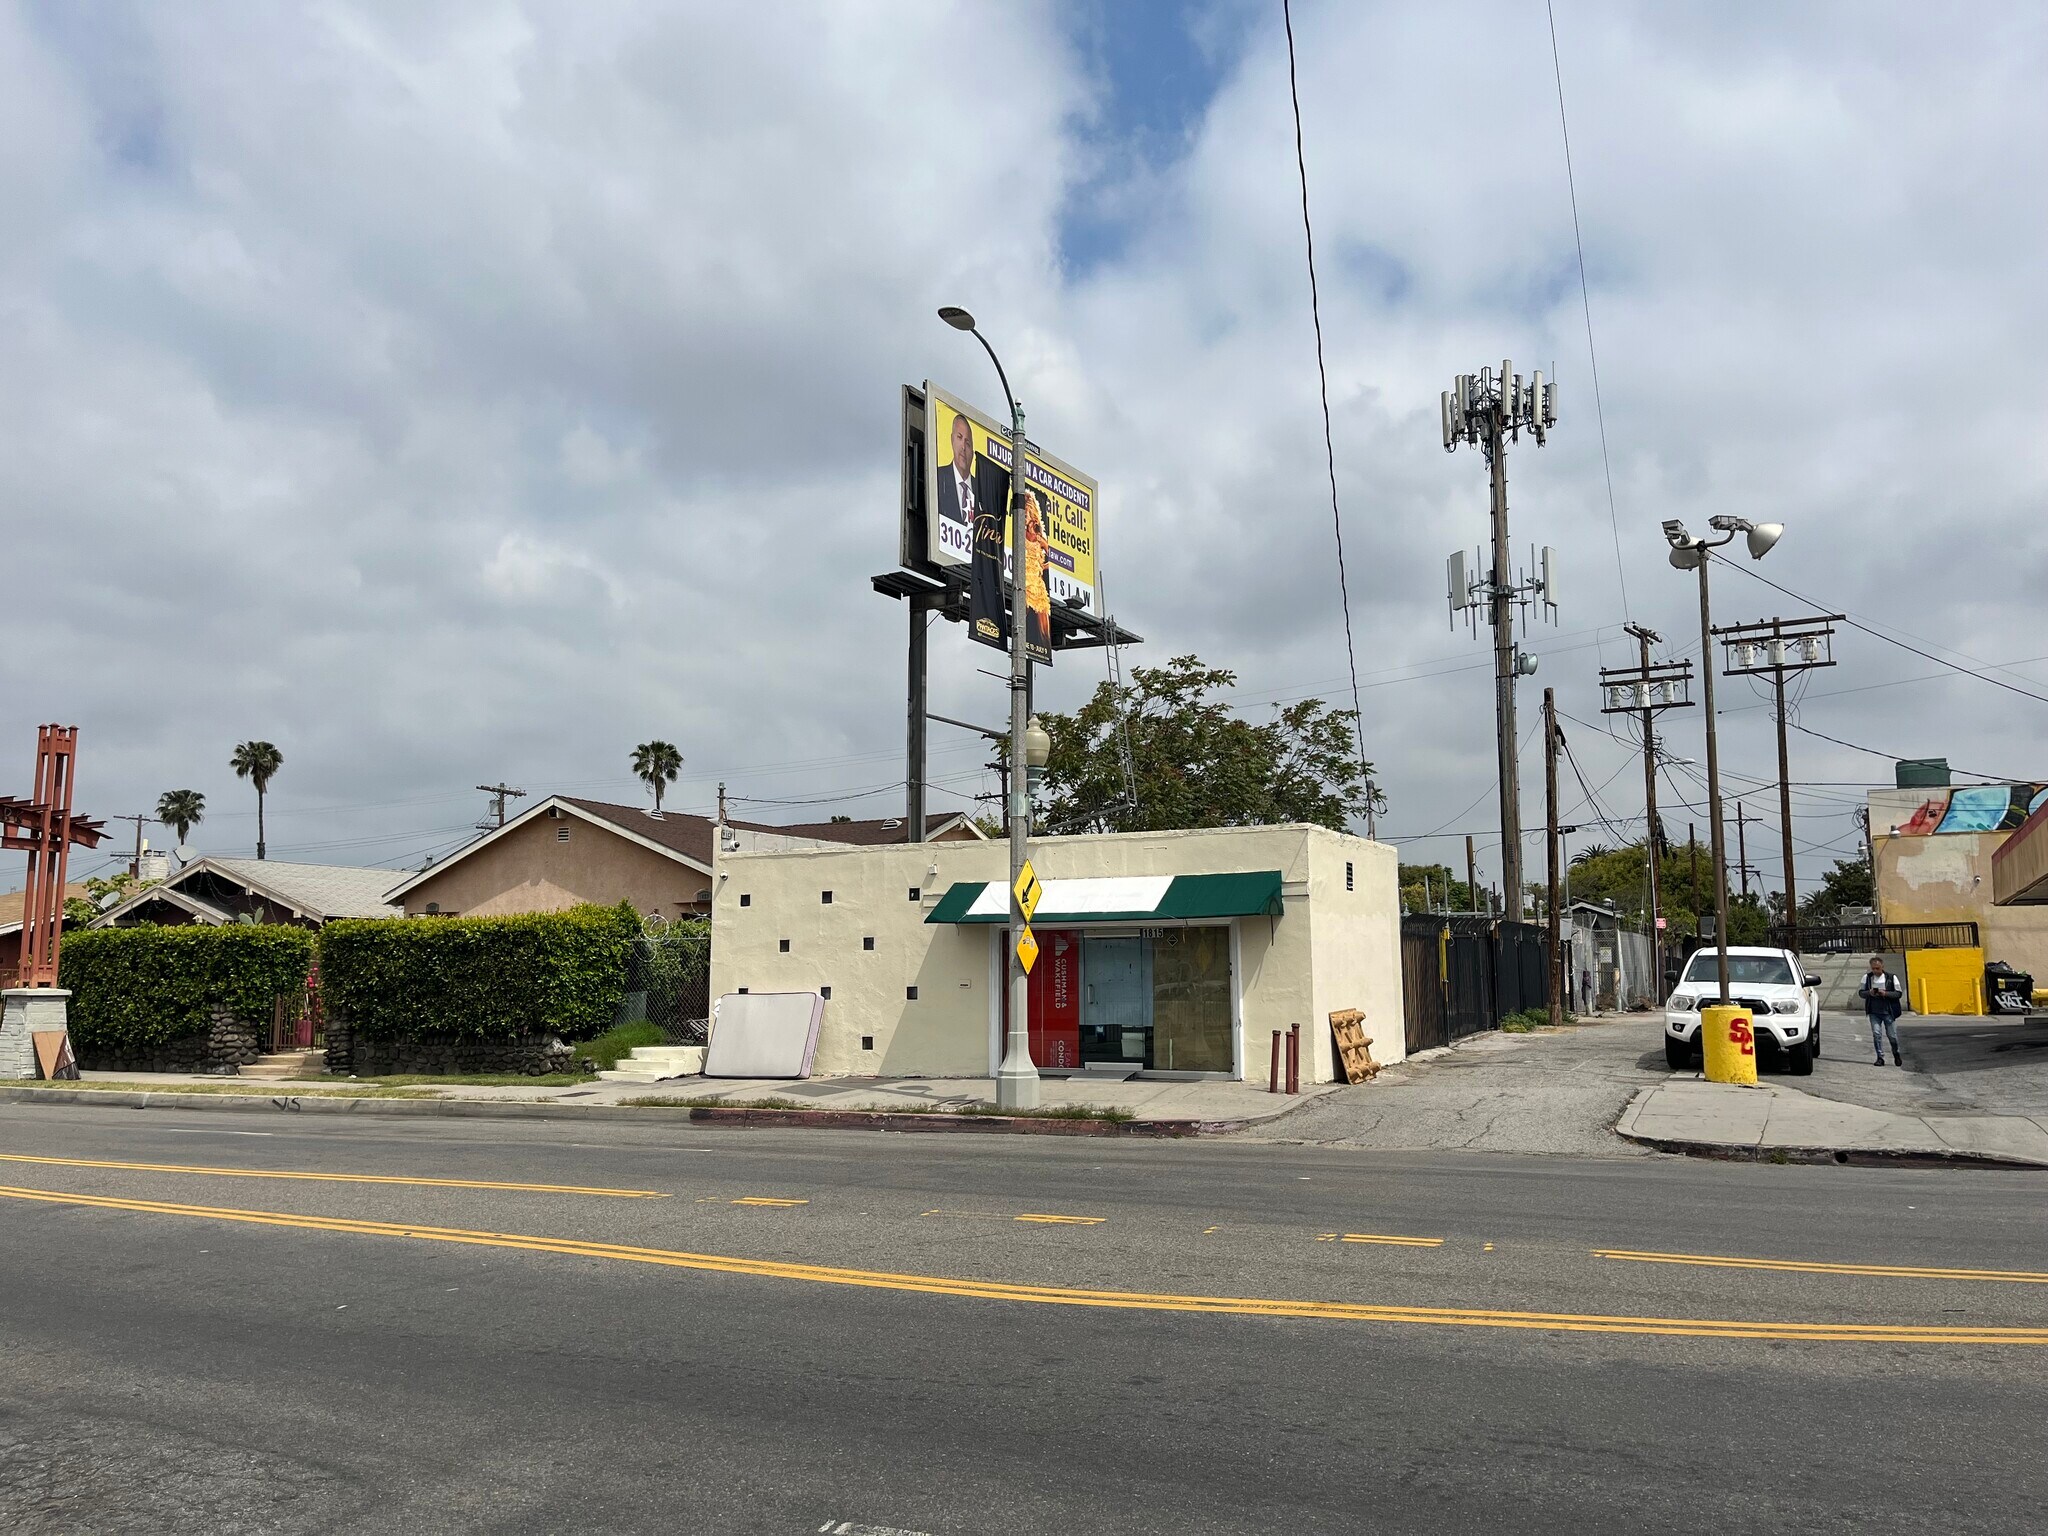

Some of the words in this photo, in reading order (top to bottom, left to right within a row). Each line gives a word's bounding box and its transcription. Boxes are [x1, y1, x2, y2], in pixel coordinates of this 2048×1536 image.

[989, 440, 1013, 466] INJUR
[1032, 471, 1038, 480] A
[1038, 472, 1053, 489] CAR
[1053, 480, 1089, 508] ACCIDENT?
[1046, 496, 1062, 522] ait,
[1065, 504, 1087, 532] Call:
[1052, 520, 1090, 556] Heroes!
[1143, 928, 1164, 938] 1815
